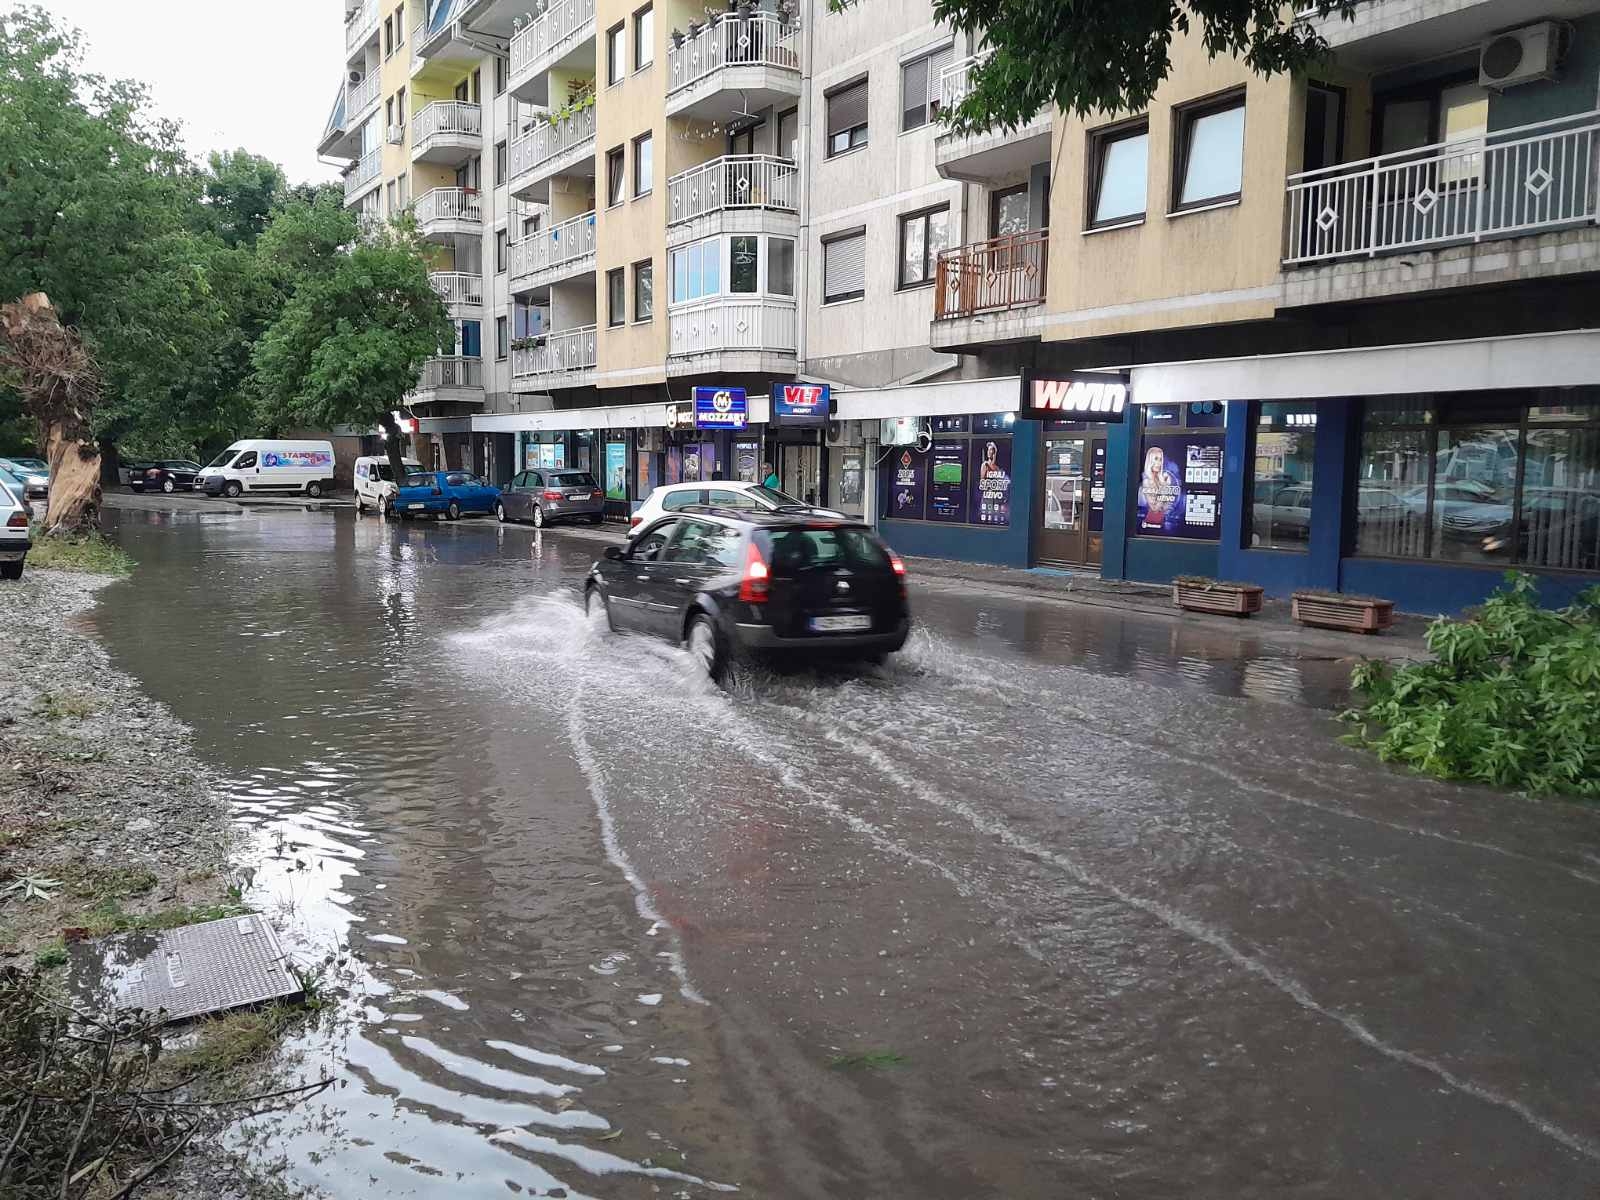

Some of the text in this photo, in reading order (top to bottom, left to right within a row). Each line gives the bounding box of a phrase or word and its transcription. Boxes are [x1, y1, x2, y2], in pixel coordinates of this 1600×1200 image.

[698, 413, 746, 422] MOZZART
[986, 471, 1006, 479] IGRAJ
[979, 479, 1011, 491] SPORT
